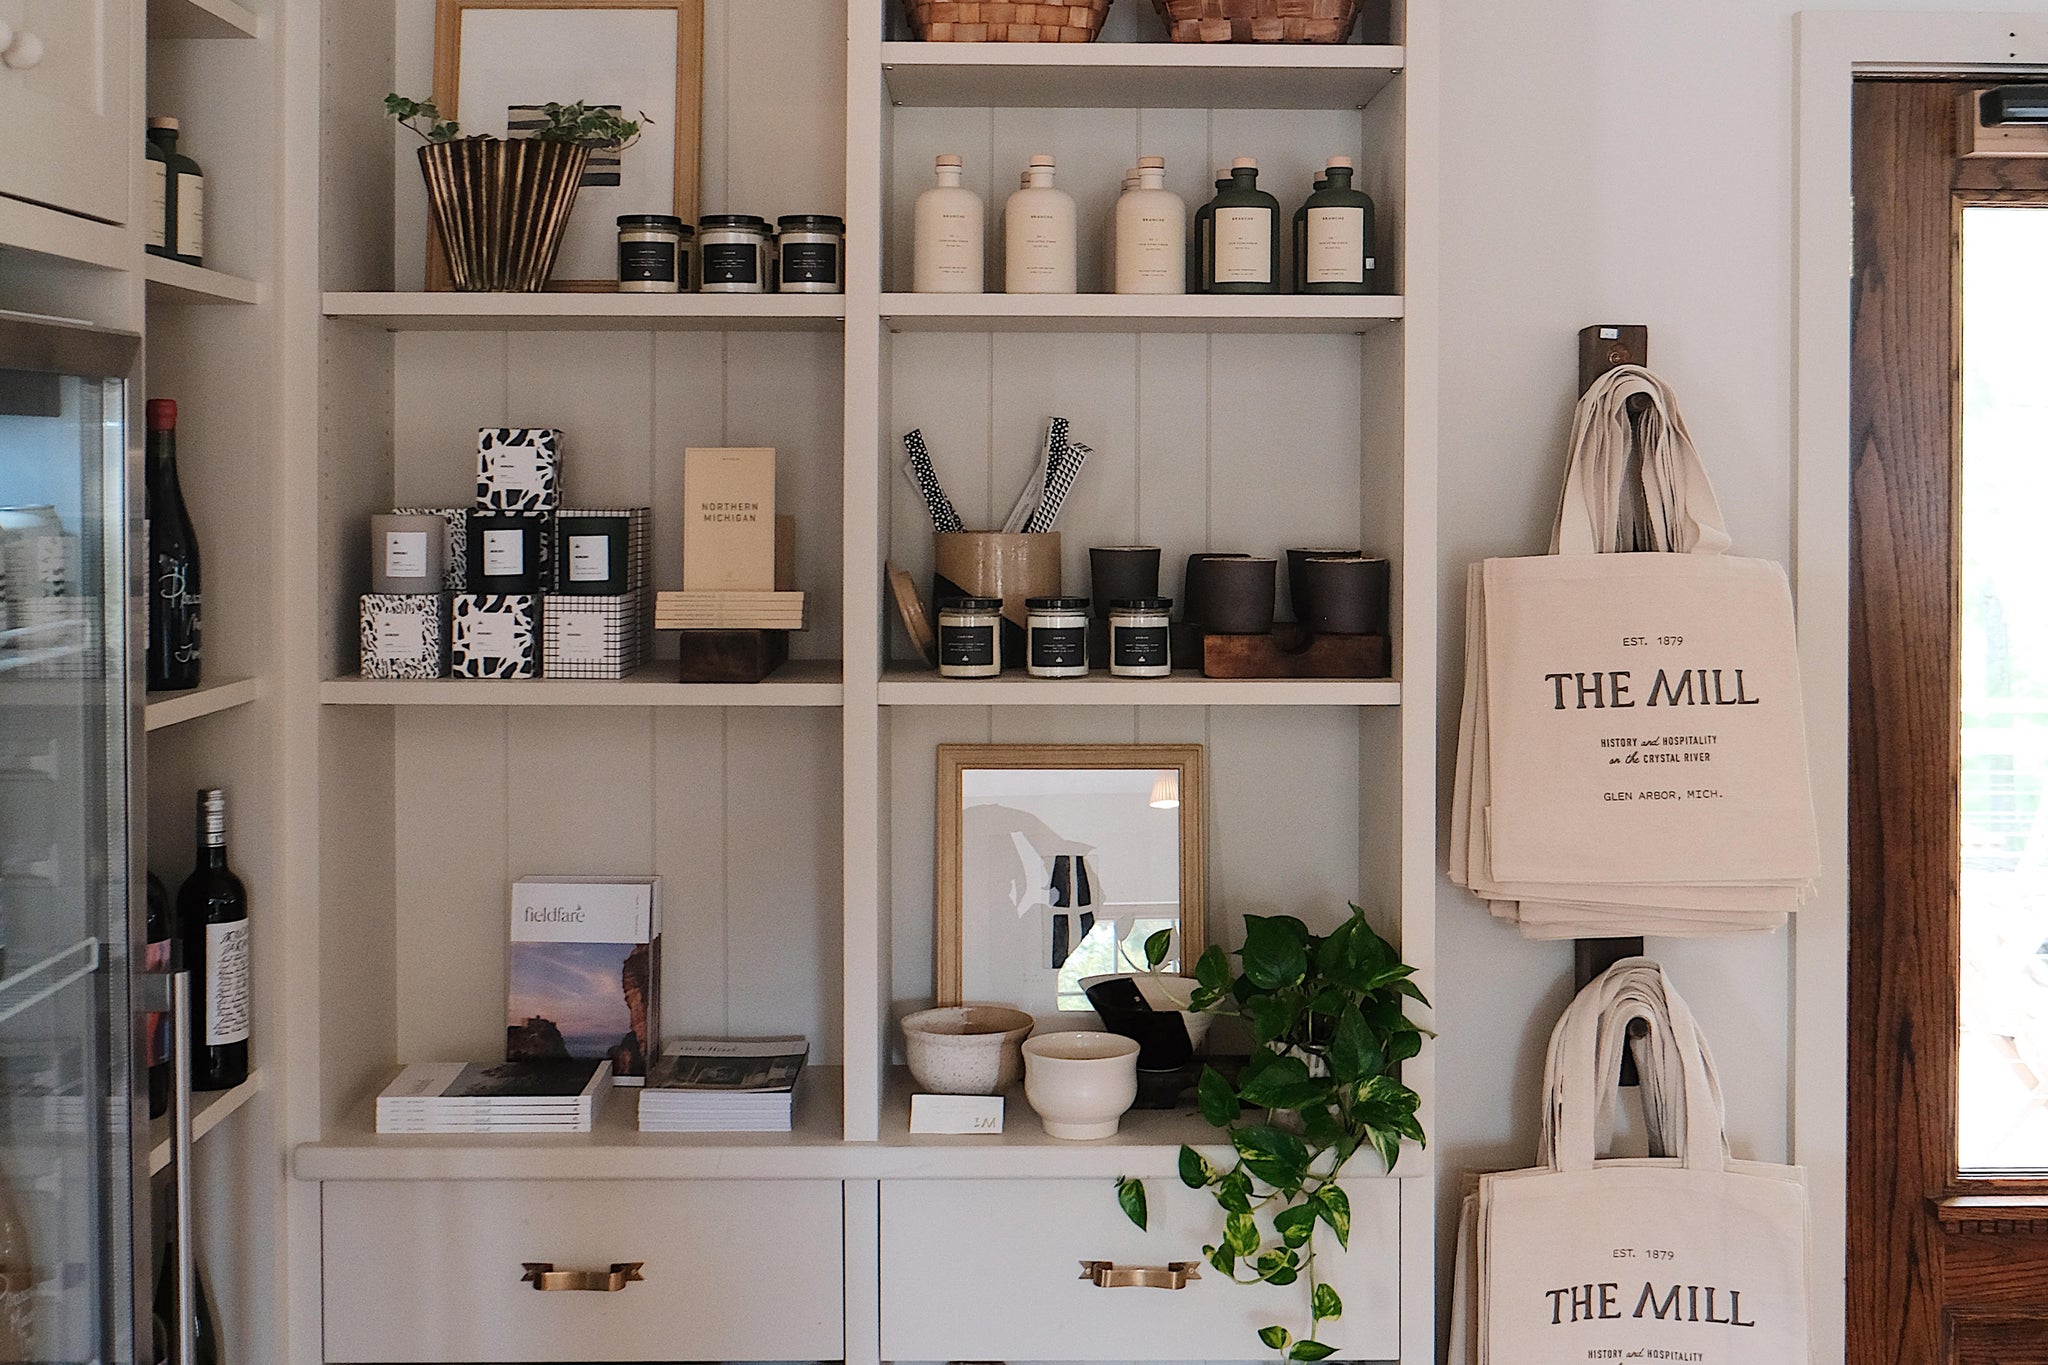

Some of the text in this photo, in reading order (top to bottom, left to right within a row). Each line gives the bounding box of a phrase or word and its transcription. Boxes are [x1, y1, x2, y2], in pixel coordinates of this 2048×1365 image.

[702, 502, 759, 511] NORTHERN
[704, 513, 756, 522] MICHIGAN
[1622, 636, 1684, 646] EST. 1879
[1545, 668, 1760, 710] THE MILL
[1600, 735, 1718, 748] HISTORY and HOSPITALITY
[1625, 751, 1640, 764] the
[1643, 753, 1680, 763] CRYSTAL
[1684, 752, 1711, 762] RIVER
[1603, 789, 1724, 801] GLEN ARBOR, MICH.
[524, 905, 585, 923] fieldfare
[1612, 1248, 1675, 1260] EST. 1879
[1545, 1281, 1755, 1328] THE MILL
[1588, 1348, 1704, 1362] HISTORY and HOSPITALITY
